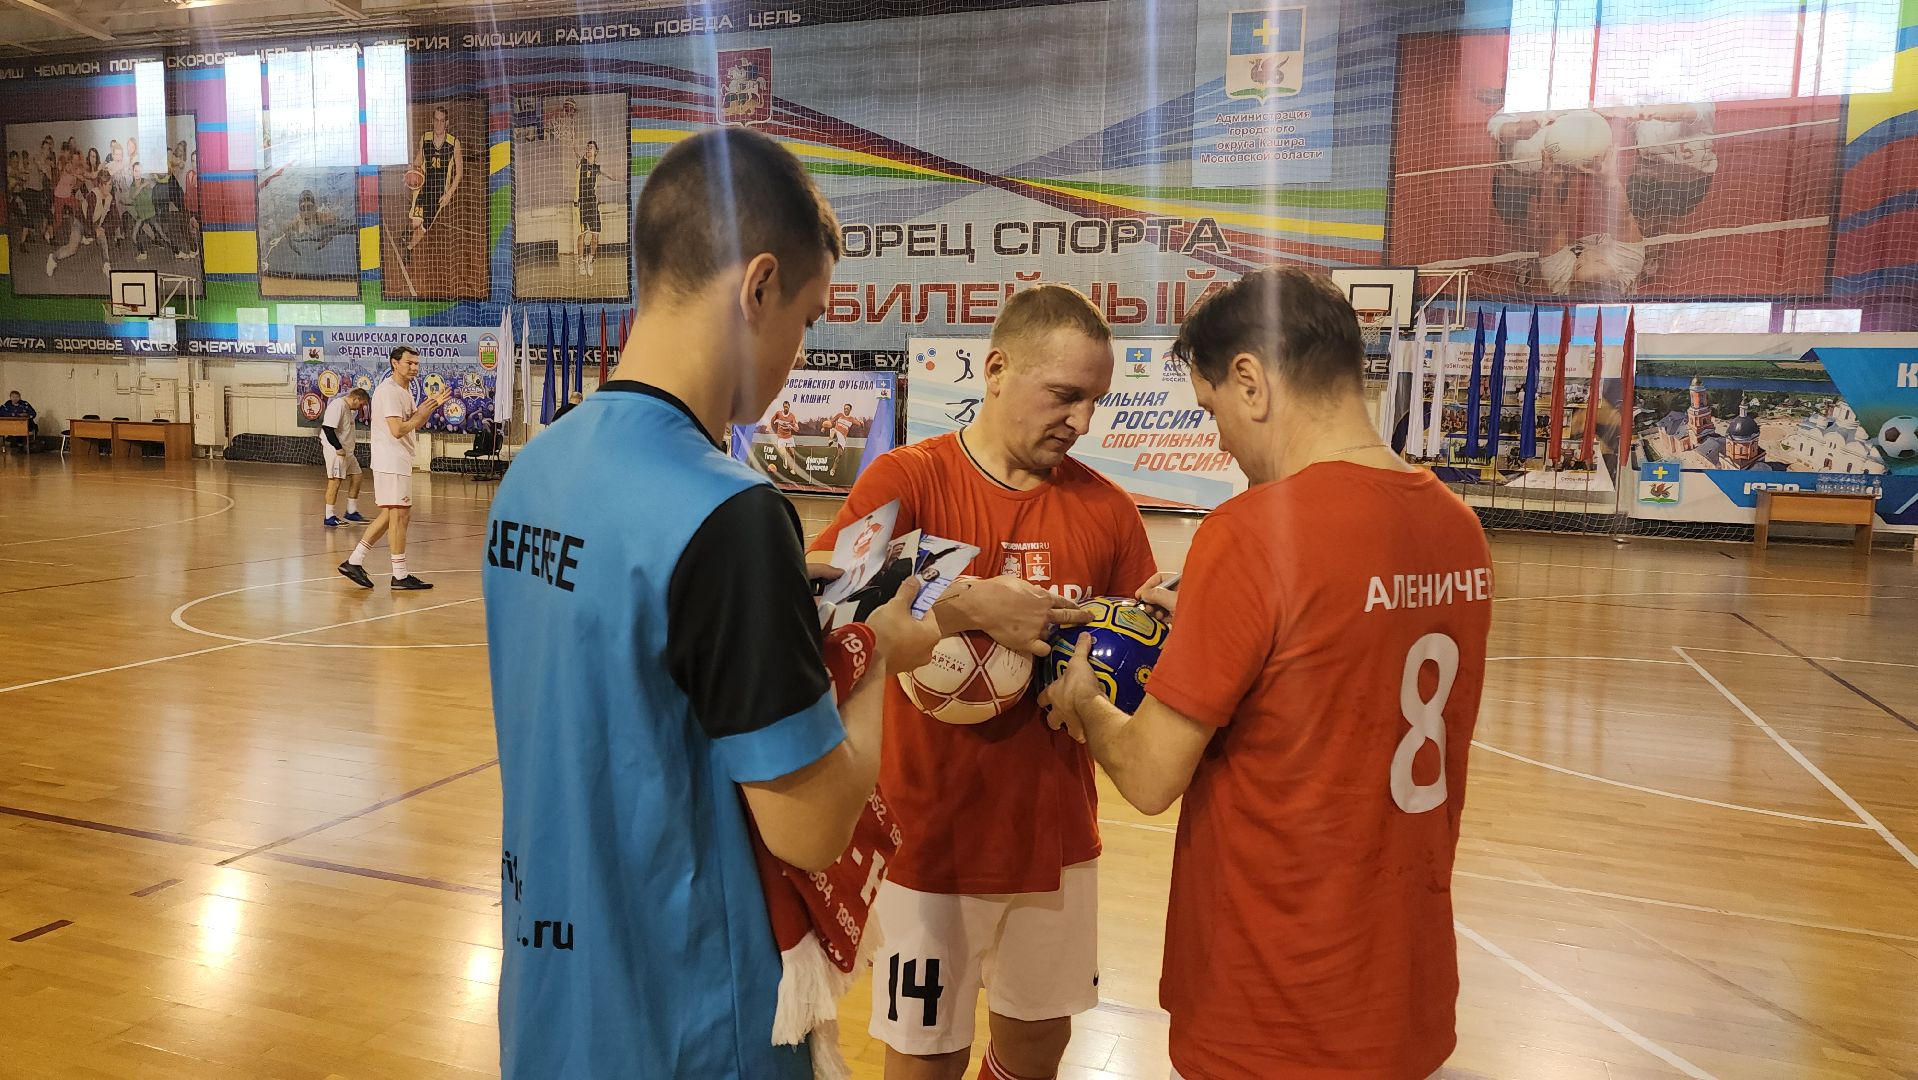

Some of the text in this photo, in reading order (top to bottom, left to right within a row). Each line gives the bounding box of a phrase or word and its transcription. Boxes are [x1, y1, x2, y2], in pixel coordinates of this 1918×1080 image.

[34, 62, 100, 77] ЧЕМПИОН
[463, 30, 541, 48] ЭМОЦИИ
[556, 23, 641, 42] РАДОСТЬ
[654, 15, 733, 34] ПОБЕДА
[749, 9, 801, 29] ЦЕЛЬ
[1216, 110, 1310, 124] Администрация
[1229, 125, 1295, 137] городского
[1217, 138, 1305, 151] округа Кашира
[1201, 150, 1323, 163] Московской области
[993, 216, 1231, 256] СПОРТА
[54, 338, 124, 351] ЗДОРОВЬЕ
[131, 339, 180, 352] УСПЕХ
[189, 340, 257, 354] ЭНЕРГИЯ
[331, 331, 467, 345] КАШИРСКАЯ ГОРОДСКАЯ
[800, 394, 832, 404] КАШИРЕ
[1110, 410, 1205, 430] РОССИЯ
[1101, 432, 1217, 449] СПОРТИВНАЯ
[1133, 452, 1232, 472] РОССИЯ!
[1390, 632, 1460, 814] 8
[887, 951, 944, 1027] 14
